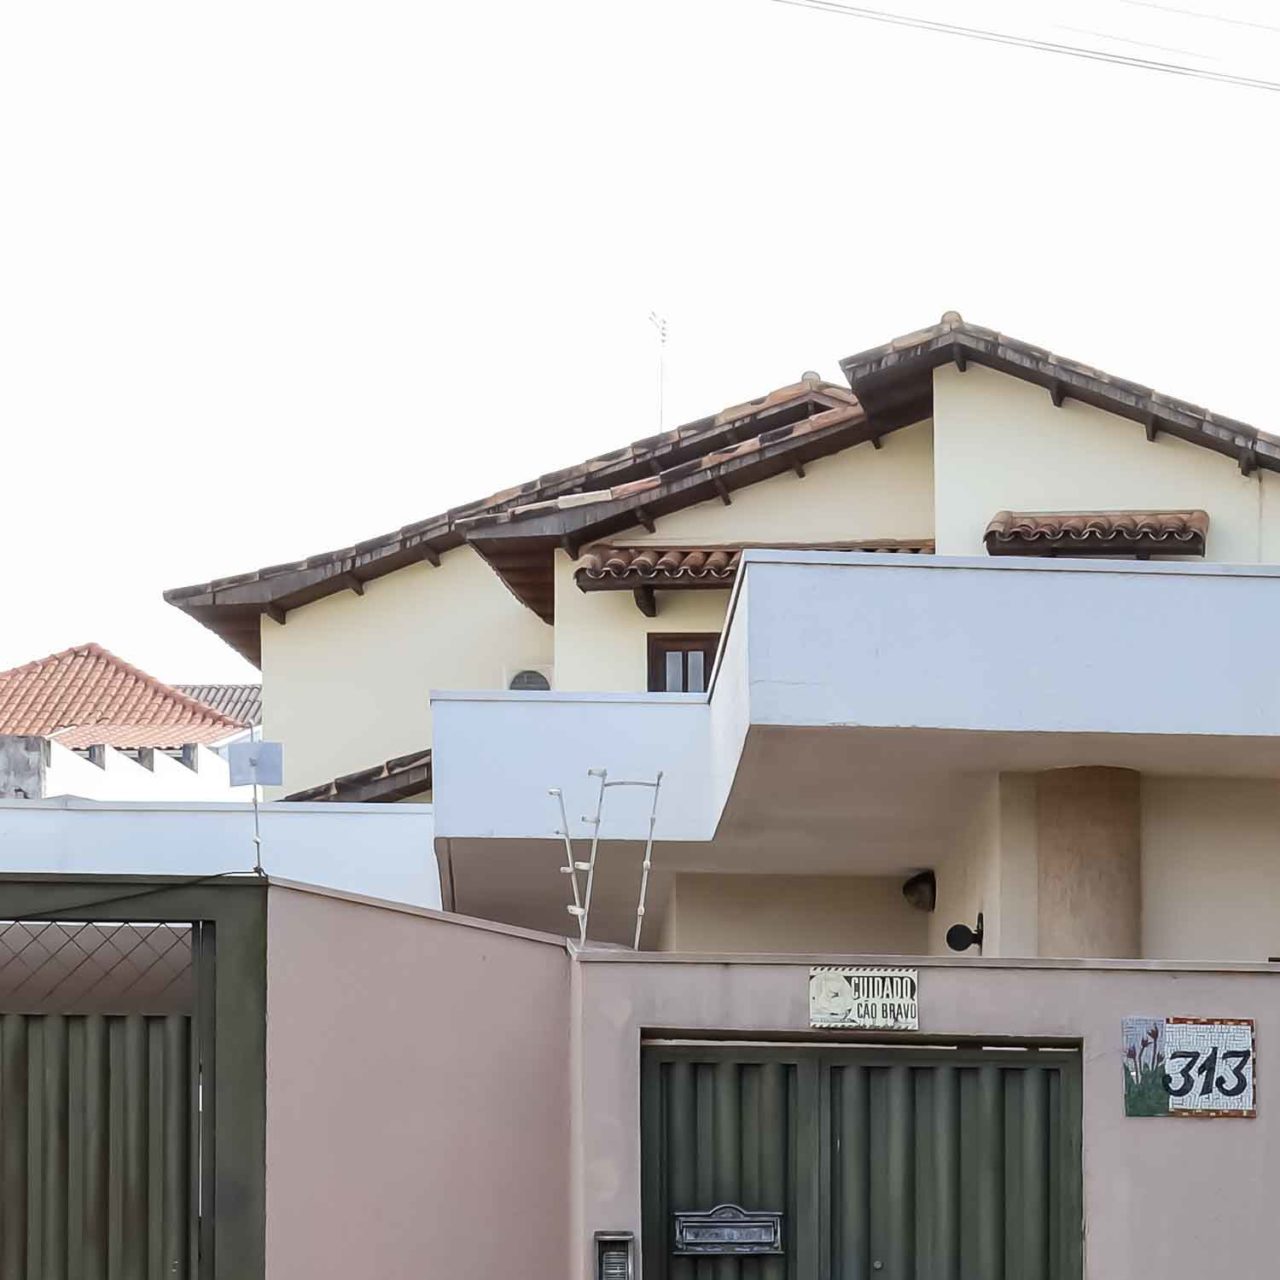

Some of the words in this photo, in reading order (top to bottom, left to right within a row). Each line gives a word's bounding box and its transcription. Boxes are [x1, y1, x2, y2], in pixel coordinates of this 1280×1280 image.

[851, 976, 911, 999] CUIDADO
[857, 1000, 877, 1019] CÃO
[881, 1003, 917, 1019] BRAVO
[1162, 1046, 1251, 1097] 313
